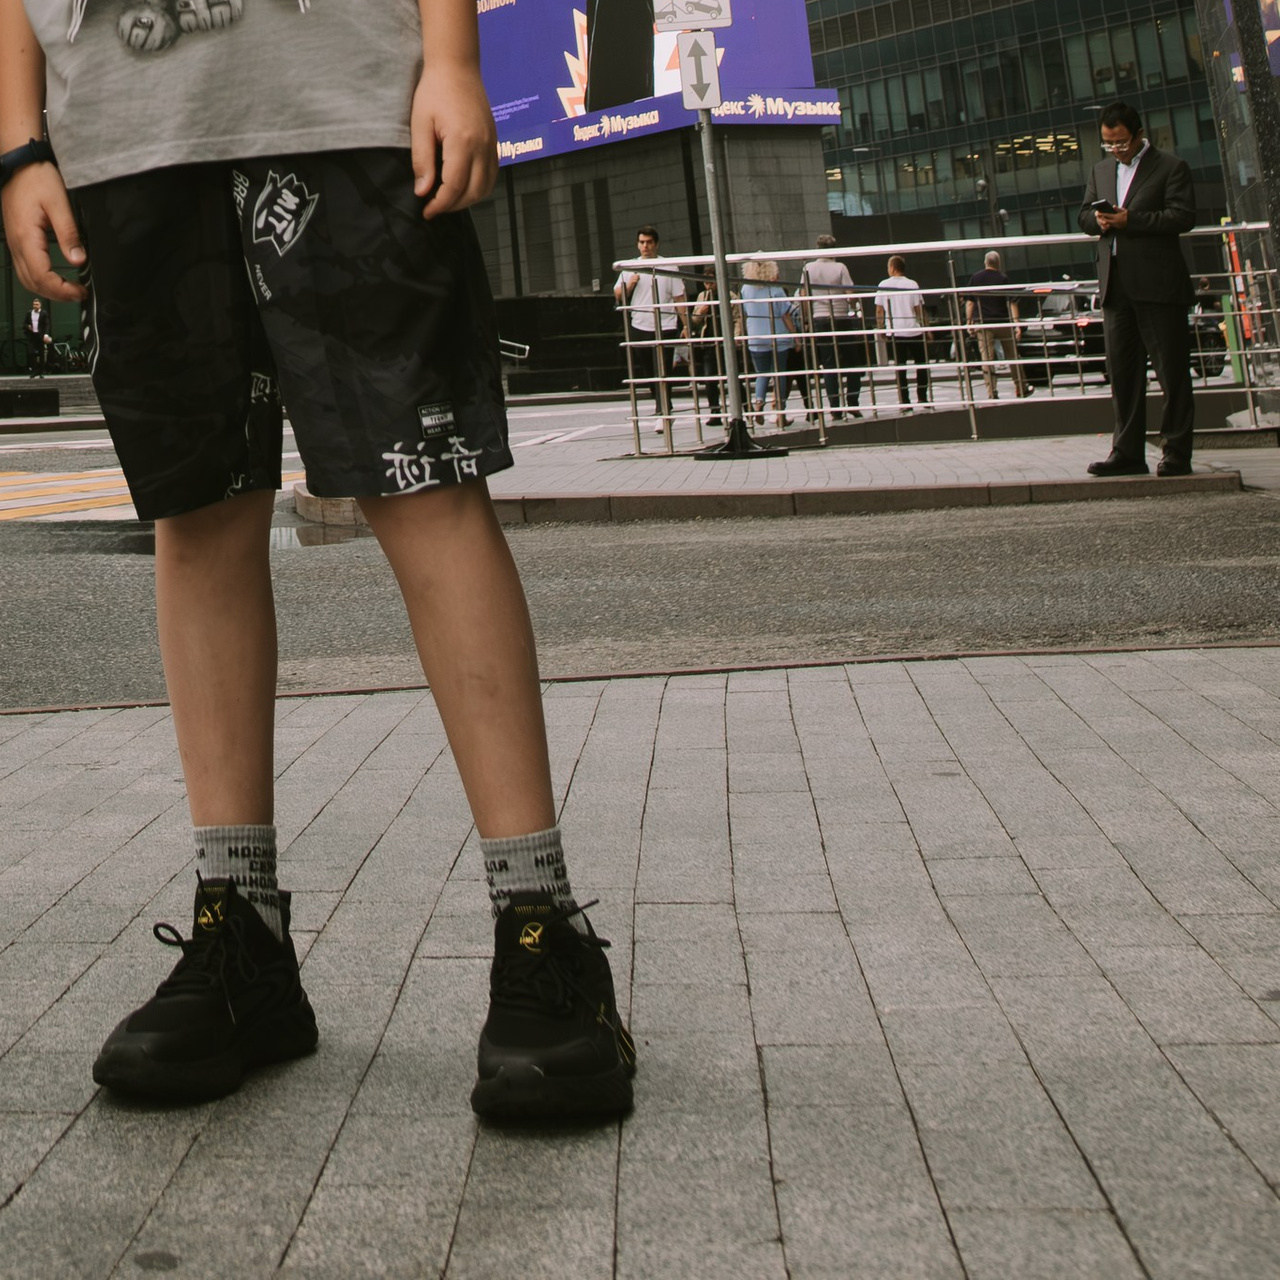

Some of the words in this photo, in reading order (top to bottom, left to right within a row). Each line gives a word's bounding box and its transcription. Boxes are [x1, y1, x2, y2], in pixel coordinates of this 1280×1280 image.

[573, 124, 600, 142] Яндекс
[610, 109, 659, 135] Музыка
[501, 137, 543, 159] Музыка
